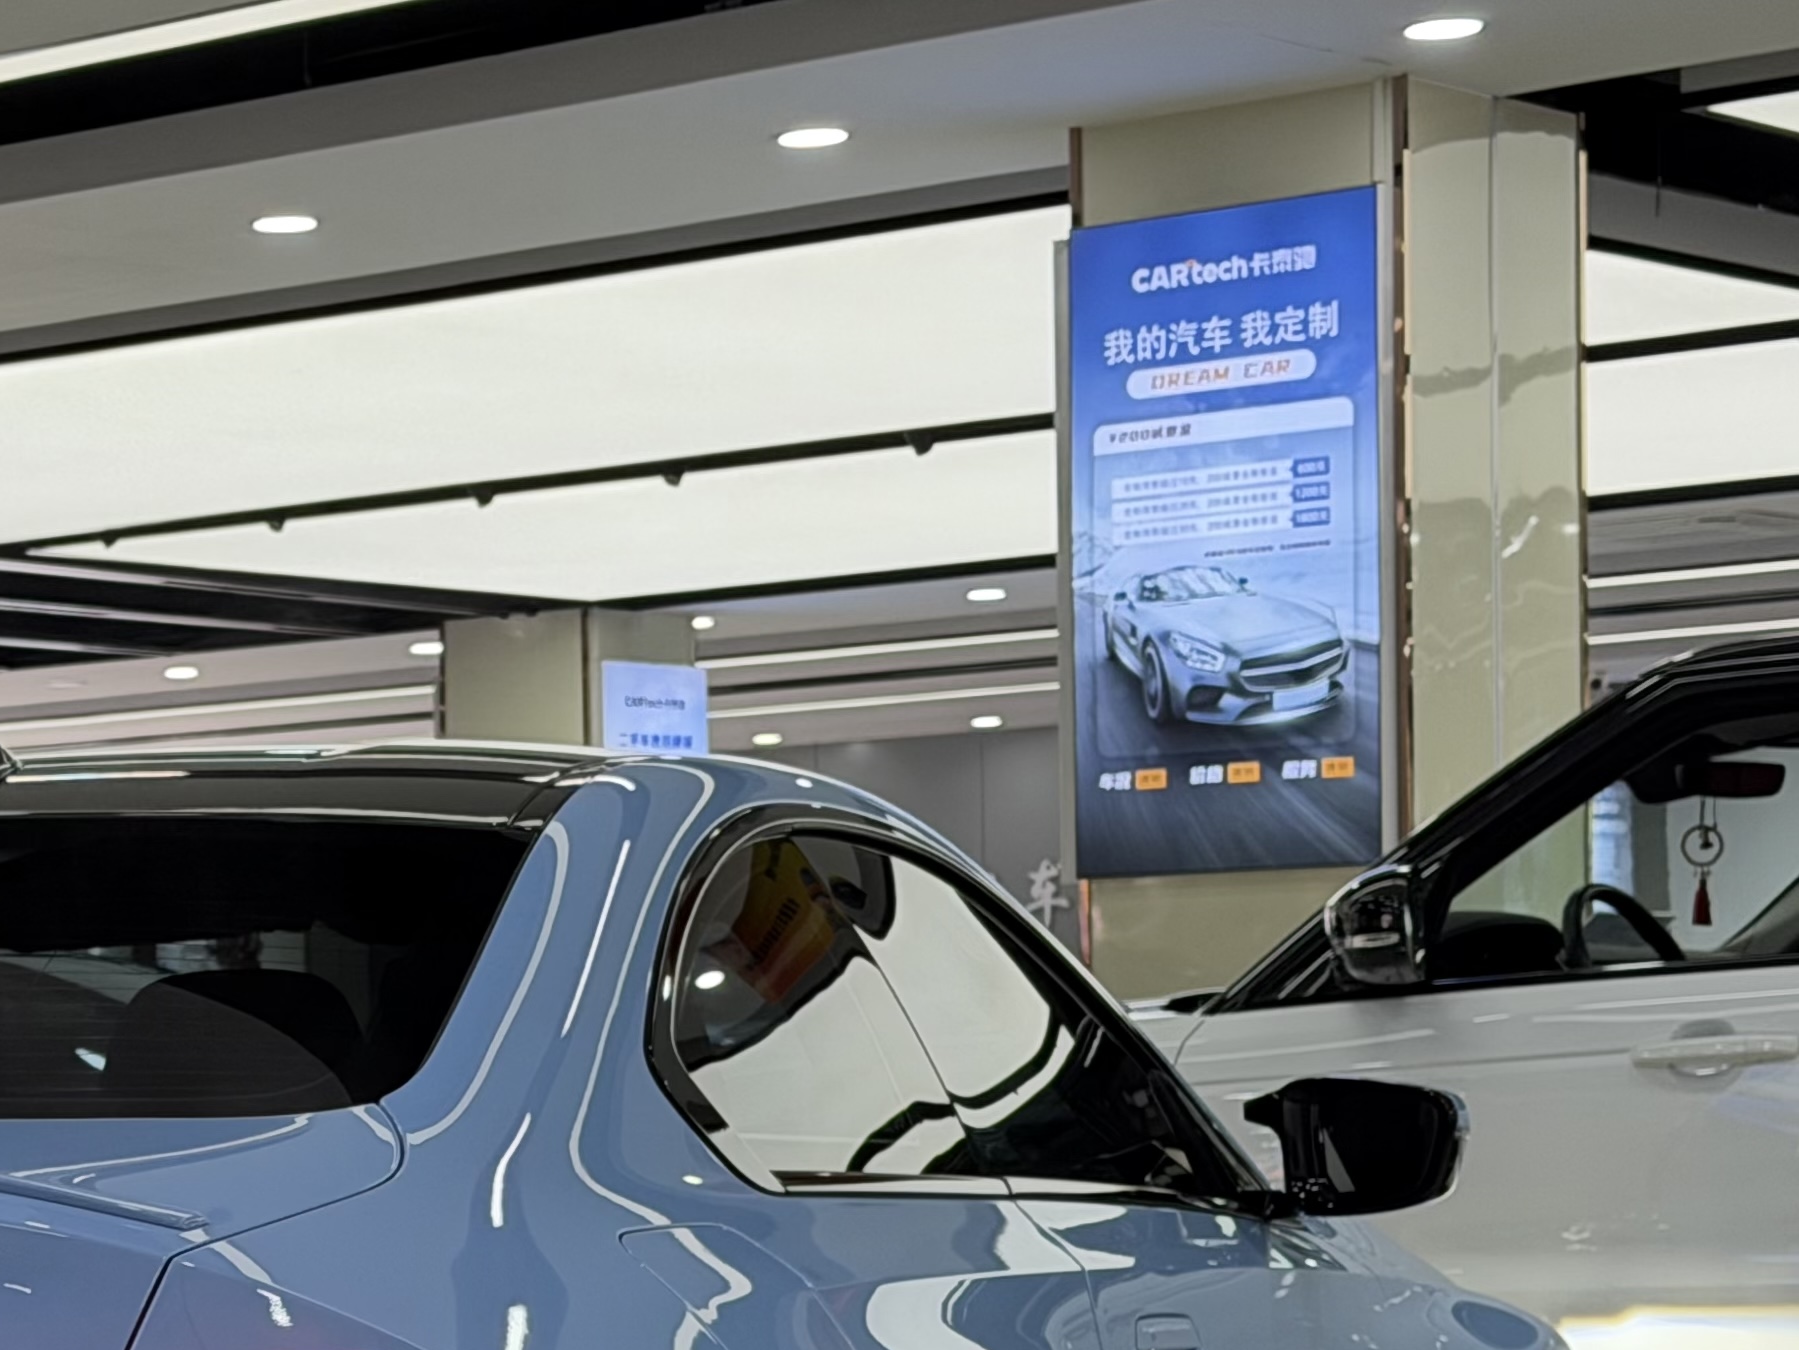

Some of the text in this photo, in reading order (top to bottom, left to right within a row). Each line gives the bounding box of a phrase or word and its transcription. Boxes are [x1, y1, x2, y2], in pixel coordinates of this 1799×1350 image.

[1103, 299, 1341, 366] 我的汽车 我定制
[1150, 357, 1292, 391] DREAM CAR
